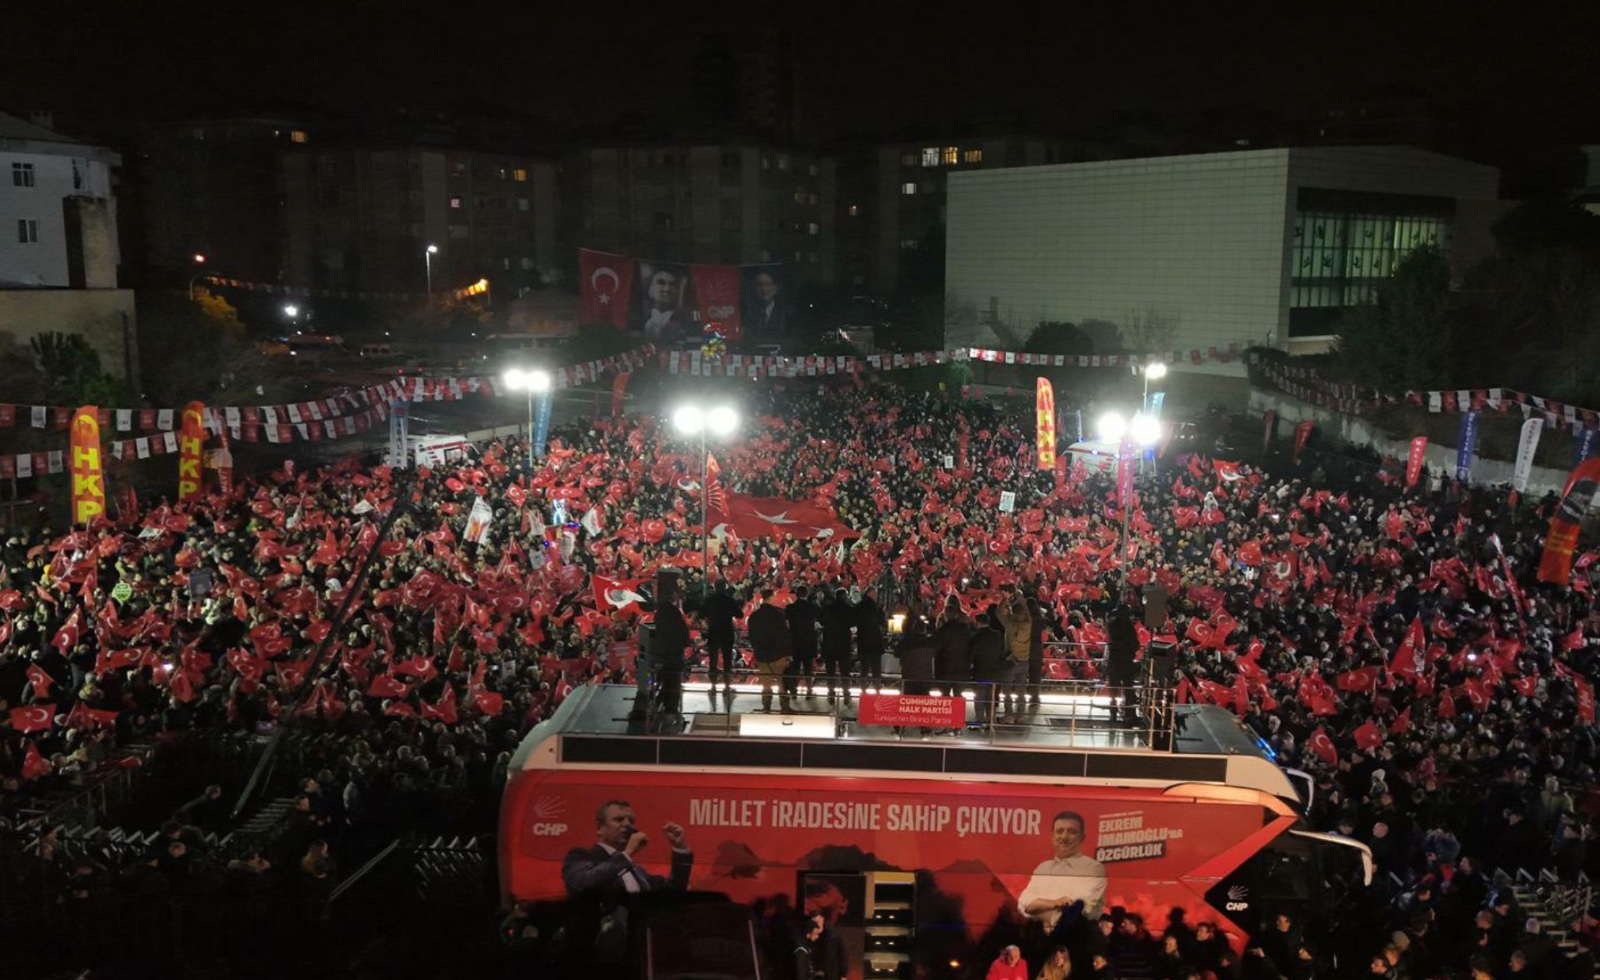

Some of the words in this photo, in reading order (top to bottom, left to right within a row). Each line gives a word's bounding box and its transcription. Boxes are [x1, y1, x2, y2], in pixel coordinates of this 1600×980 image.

[179, 436, 200, 499] HKP
[74, 446, 104, 523] HKP
[900, 697, 952, 706] CUMHURİYET
[922, 706, 952, 714] PARTİSİ
[533, 822, 568, 836] CHP
[957, 806, 1041, 837] ÇIKIYOR
[1099, 816, 1143, 832] EKREM
[1096, 843, 1163, 862] ÖZGÜRLÜK
[1226, 902, 1248, 911] CHP
